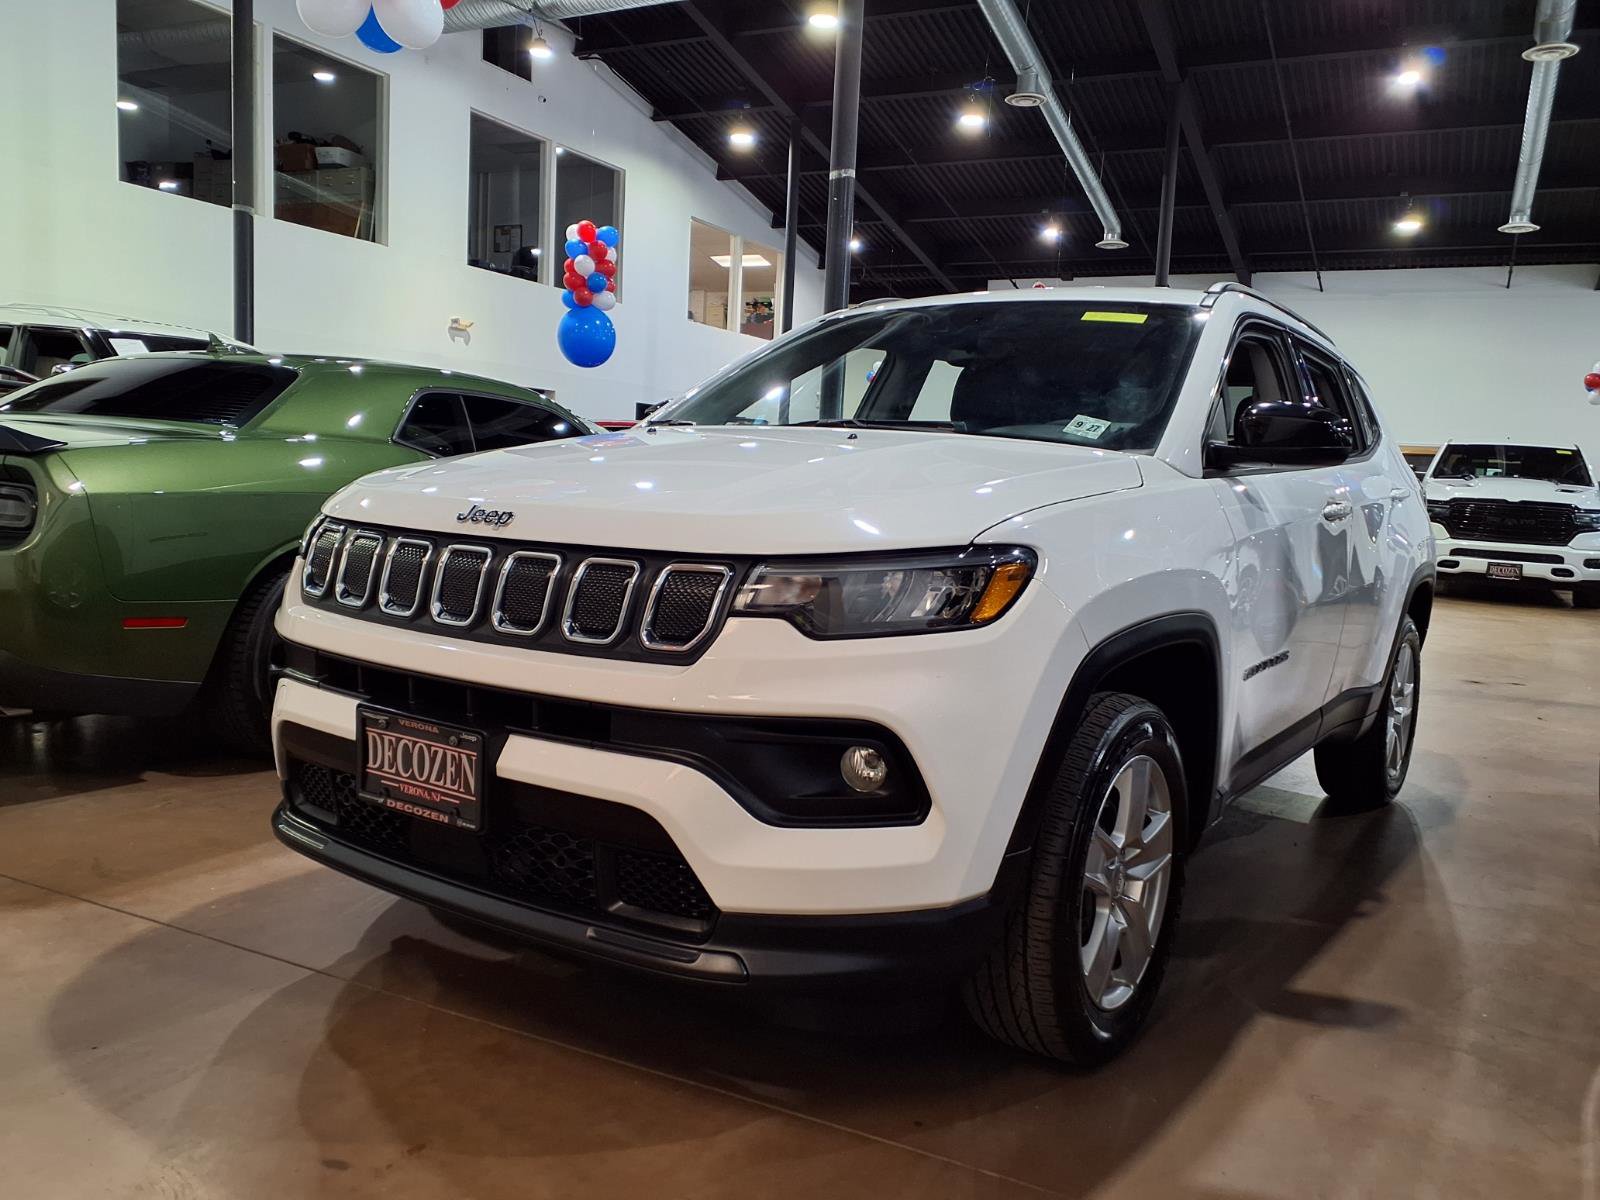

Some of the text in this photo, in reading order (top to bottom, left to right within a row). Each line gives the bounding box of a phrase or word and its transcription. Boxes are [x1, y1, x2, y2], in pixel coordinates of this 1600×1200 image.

[1086, 424, 1101, 432] 27
[457, 504, 514, 526] Jeep
[398, 719, 439, 733] VERONA
[366, 731, 477, 795] DECOZEN
[386, 799, 449, 823] DECOZEN
